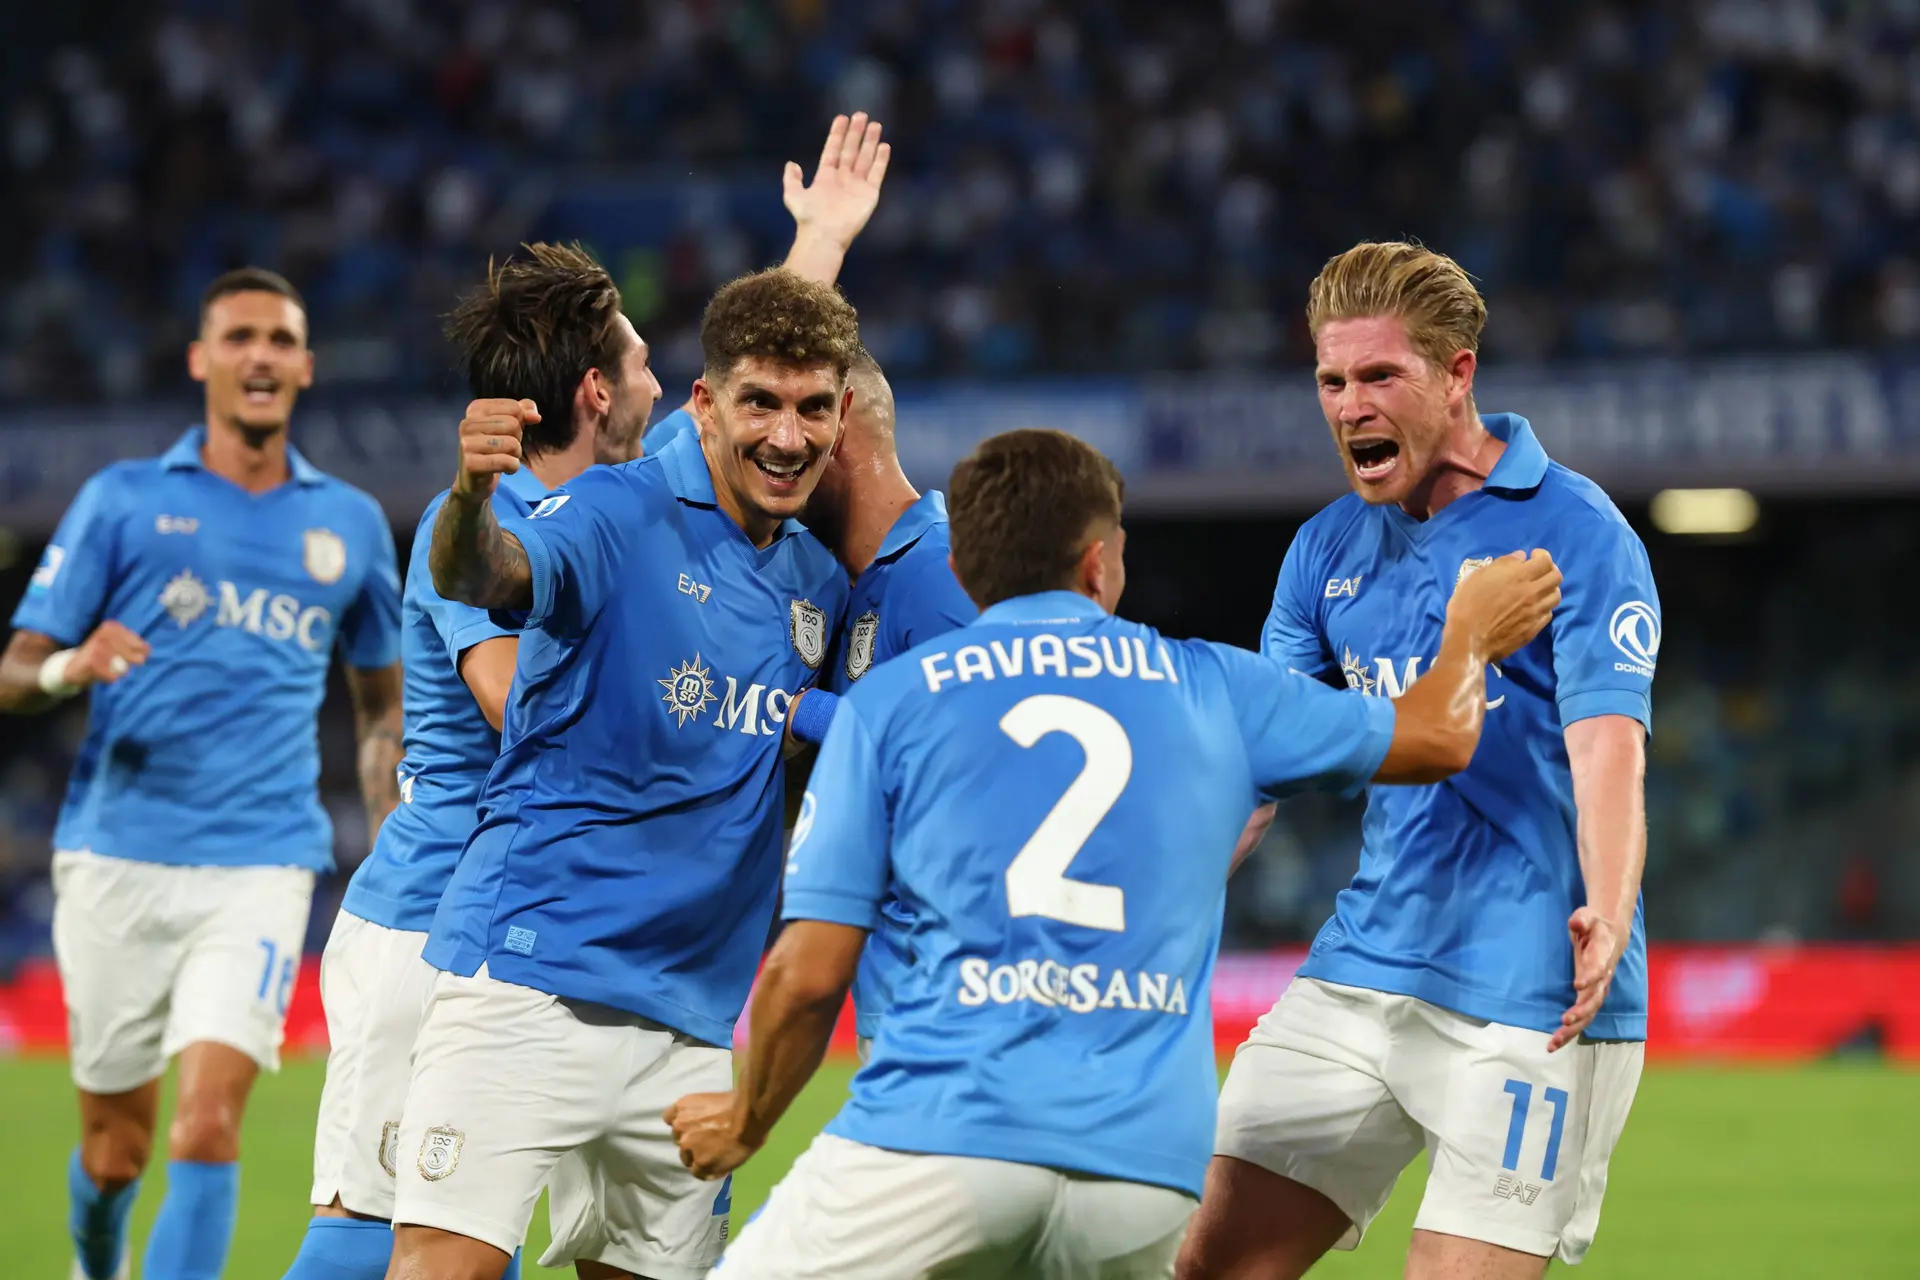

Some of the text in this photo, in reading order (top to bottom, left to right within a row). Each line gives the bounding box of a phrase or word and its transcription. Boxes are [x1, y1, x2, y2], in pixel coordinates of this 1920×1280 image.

[678, 573, 712, 604] EA7
[216, 580, 332, 651] MSC
[801, 613, 817, 626] 100
[805, 634, 814, 648] N
[857, 627, 869, 637] 100
[920, 634, 1179, 692] FAVASULI
[1614, 662, 1653, 678] DONG
[713, 675, 797, 735] MS
[999, 694, 1133, 932] 2
[1502, 1078, 1568, 1181] 11
[1493, 1174, 1542, 1206] EA7
